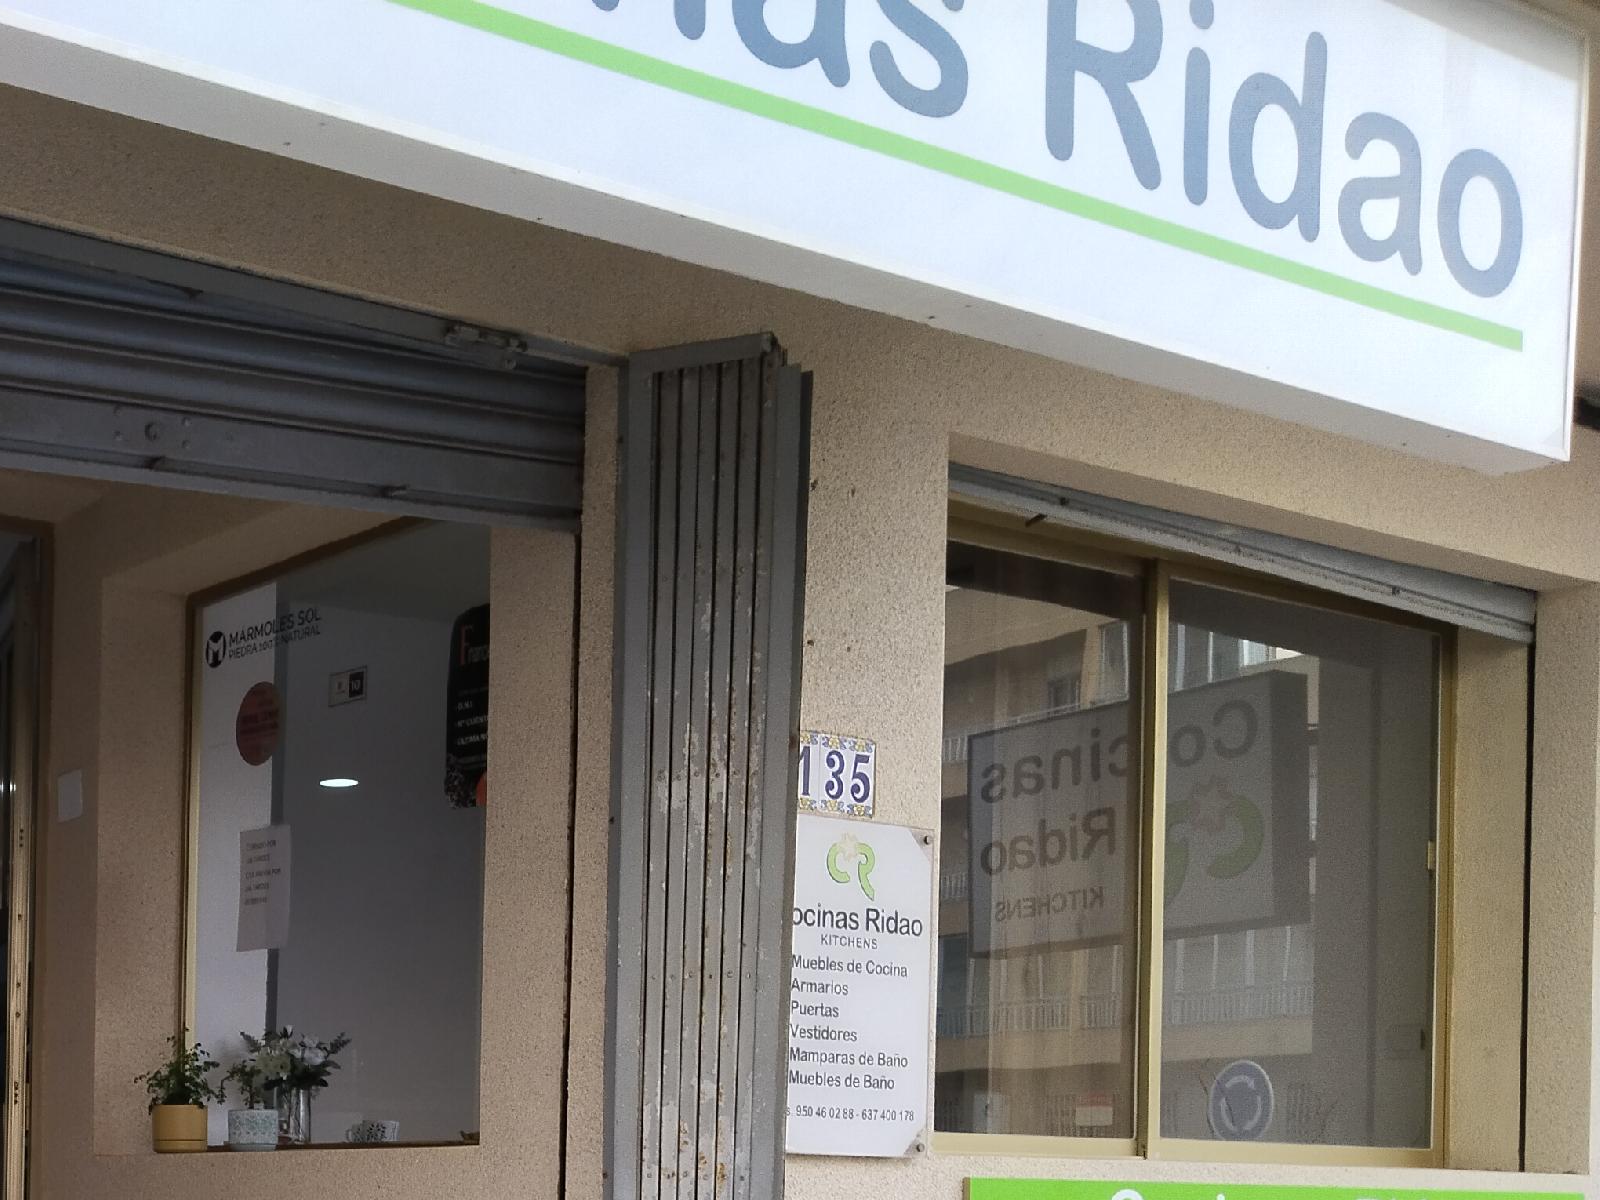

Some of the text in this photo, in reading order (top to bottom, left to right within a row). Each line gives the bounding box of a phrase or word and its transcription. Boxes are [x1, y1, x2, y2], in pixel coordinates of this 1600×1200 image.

[592, 0, 1523, 298] as Ridao
[297, 607, 322, 626] SOL
[228, 642, 258, 660] PIEDRA
[280, 624, 321, 645] NATURAL
[799, 745, 870, 803] 135
[793, 903, 923, 937] ocinas Ridao
[820, 933, 878, 950] KITCHENS
[792, 954, 908, 978] Muebles de Cocina
[791, 977, 849, 996] Armarios
[791, 1000, 839, 1018] Puertas
[790, 1024, 857, 1042] Vestidores
[789, 1047, 908, 1068] Mamparas de Baño
[788, 1070, 895, 1090] Muebles de Baño
[796, 1105, 813, 1117] 950
[815, 1107, 826, 1118] 46
[861, 1110, 878, 1121] 637
